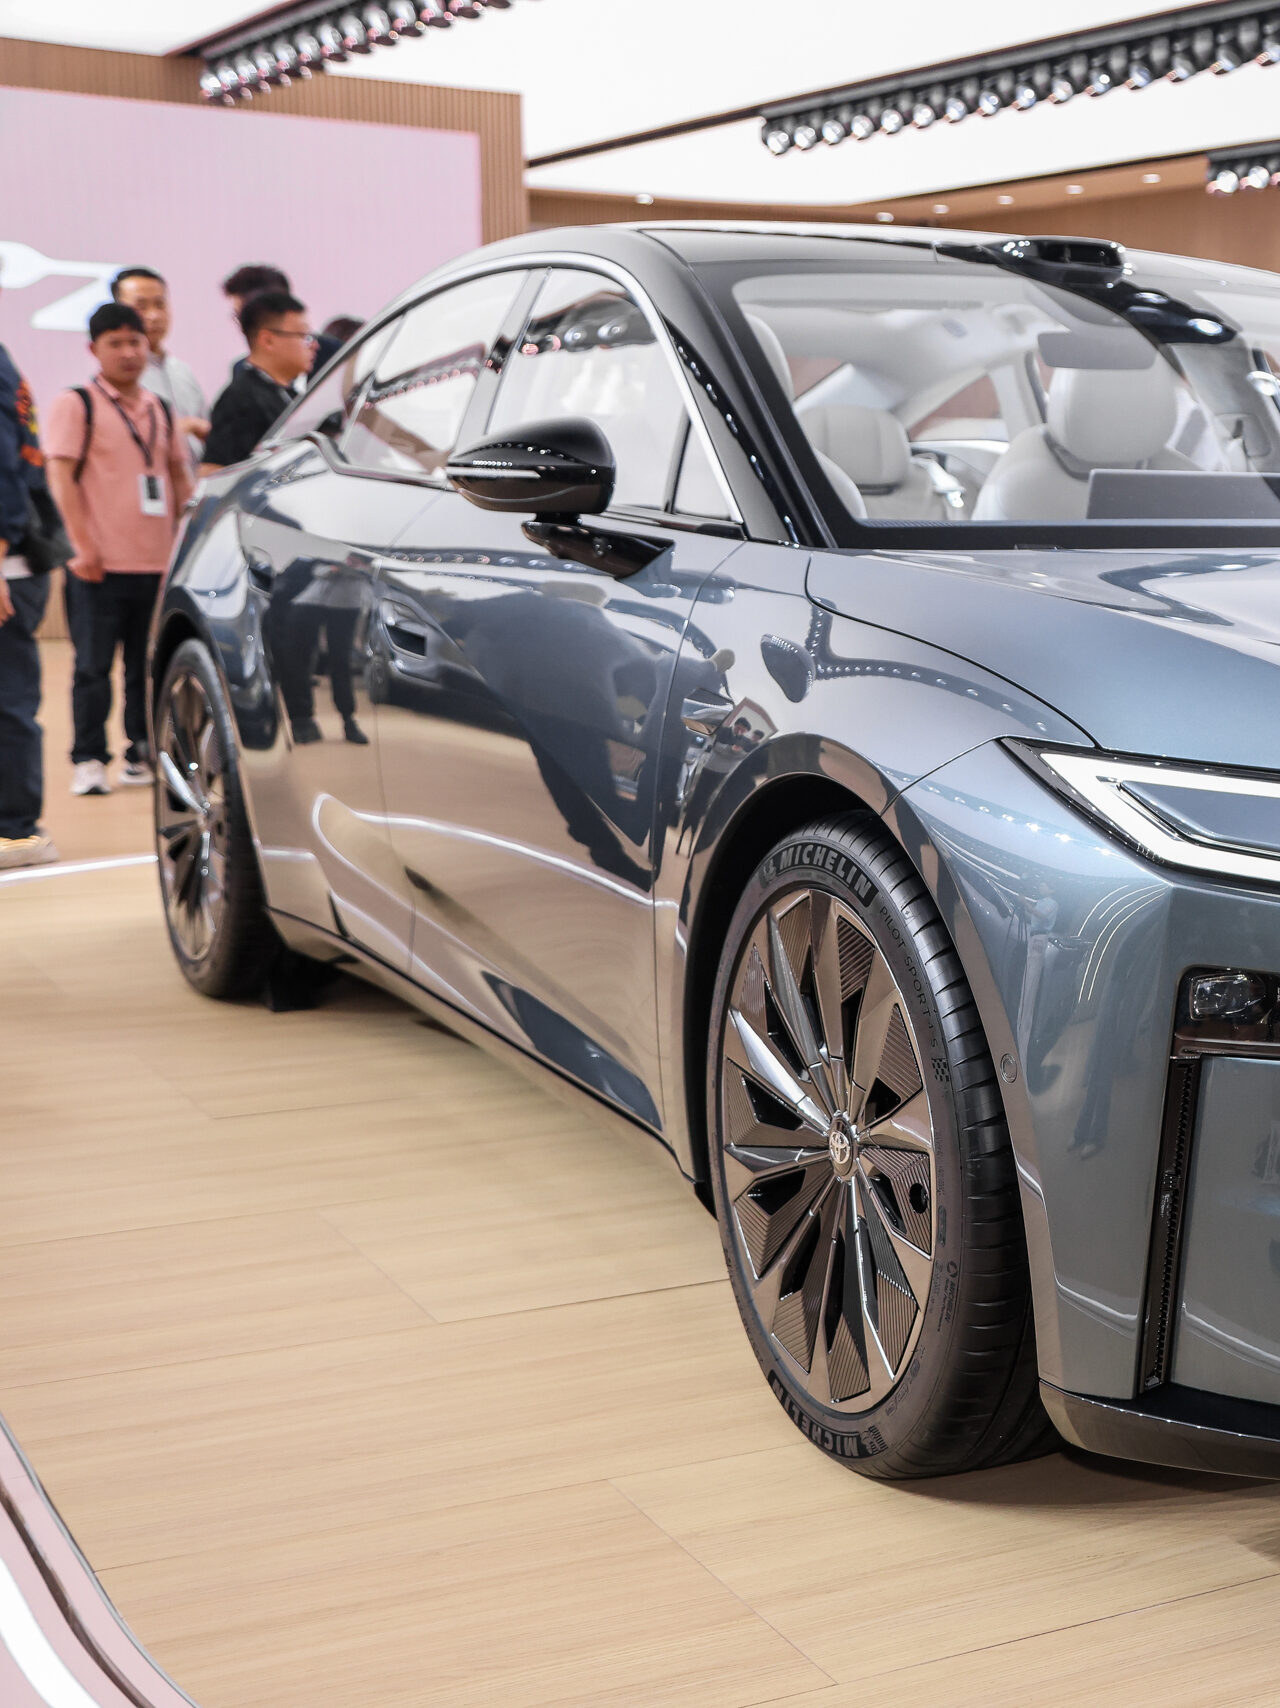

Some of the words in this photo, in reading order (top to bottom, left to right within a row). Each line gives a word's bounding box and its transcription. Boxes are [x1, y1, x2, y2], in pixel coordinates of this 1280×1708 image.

[779, 844, 872, 898] MICHELIN
[880, 905, 906, 949] PILOT
[904, 956, 931, 1016] SPORT
[772, 1378, 860, 1457] MICHELIN
